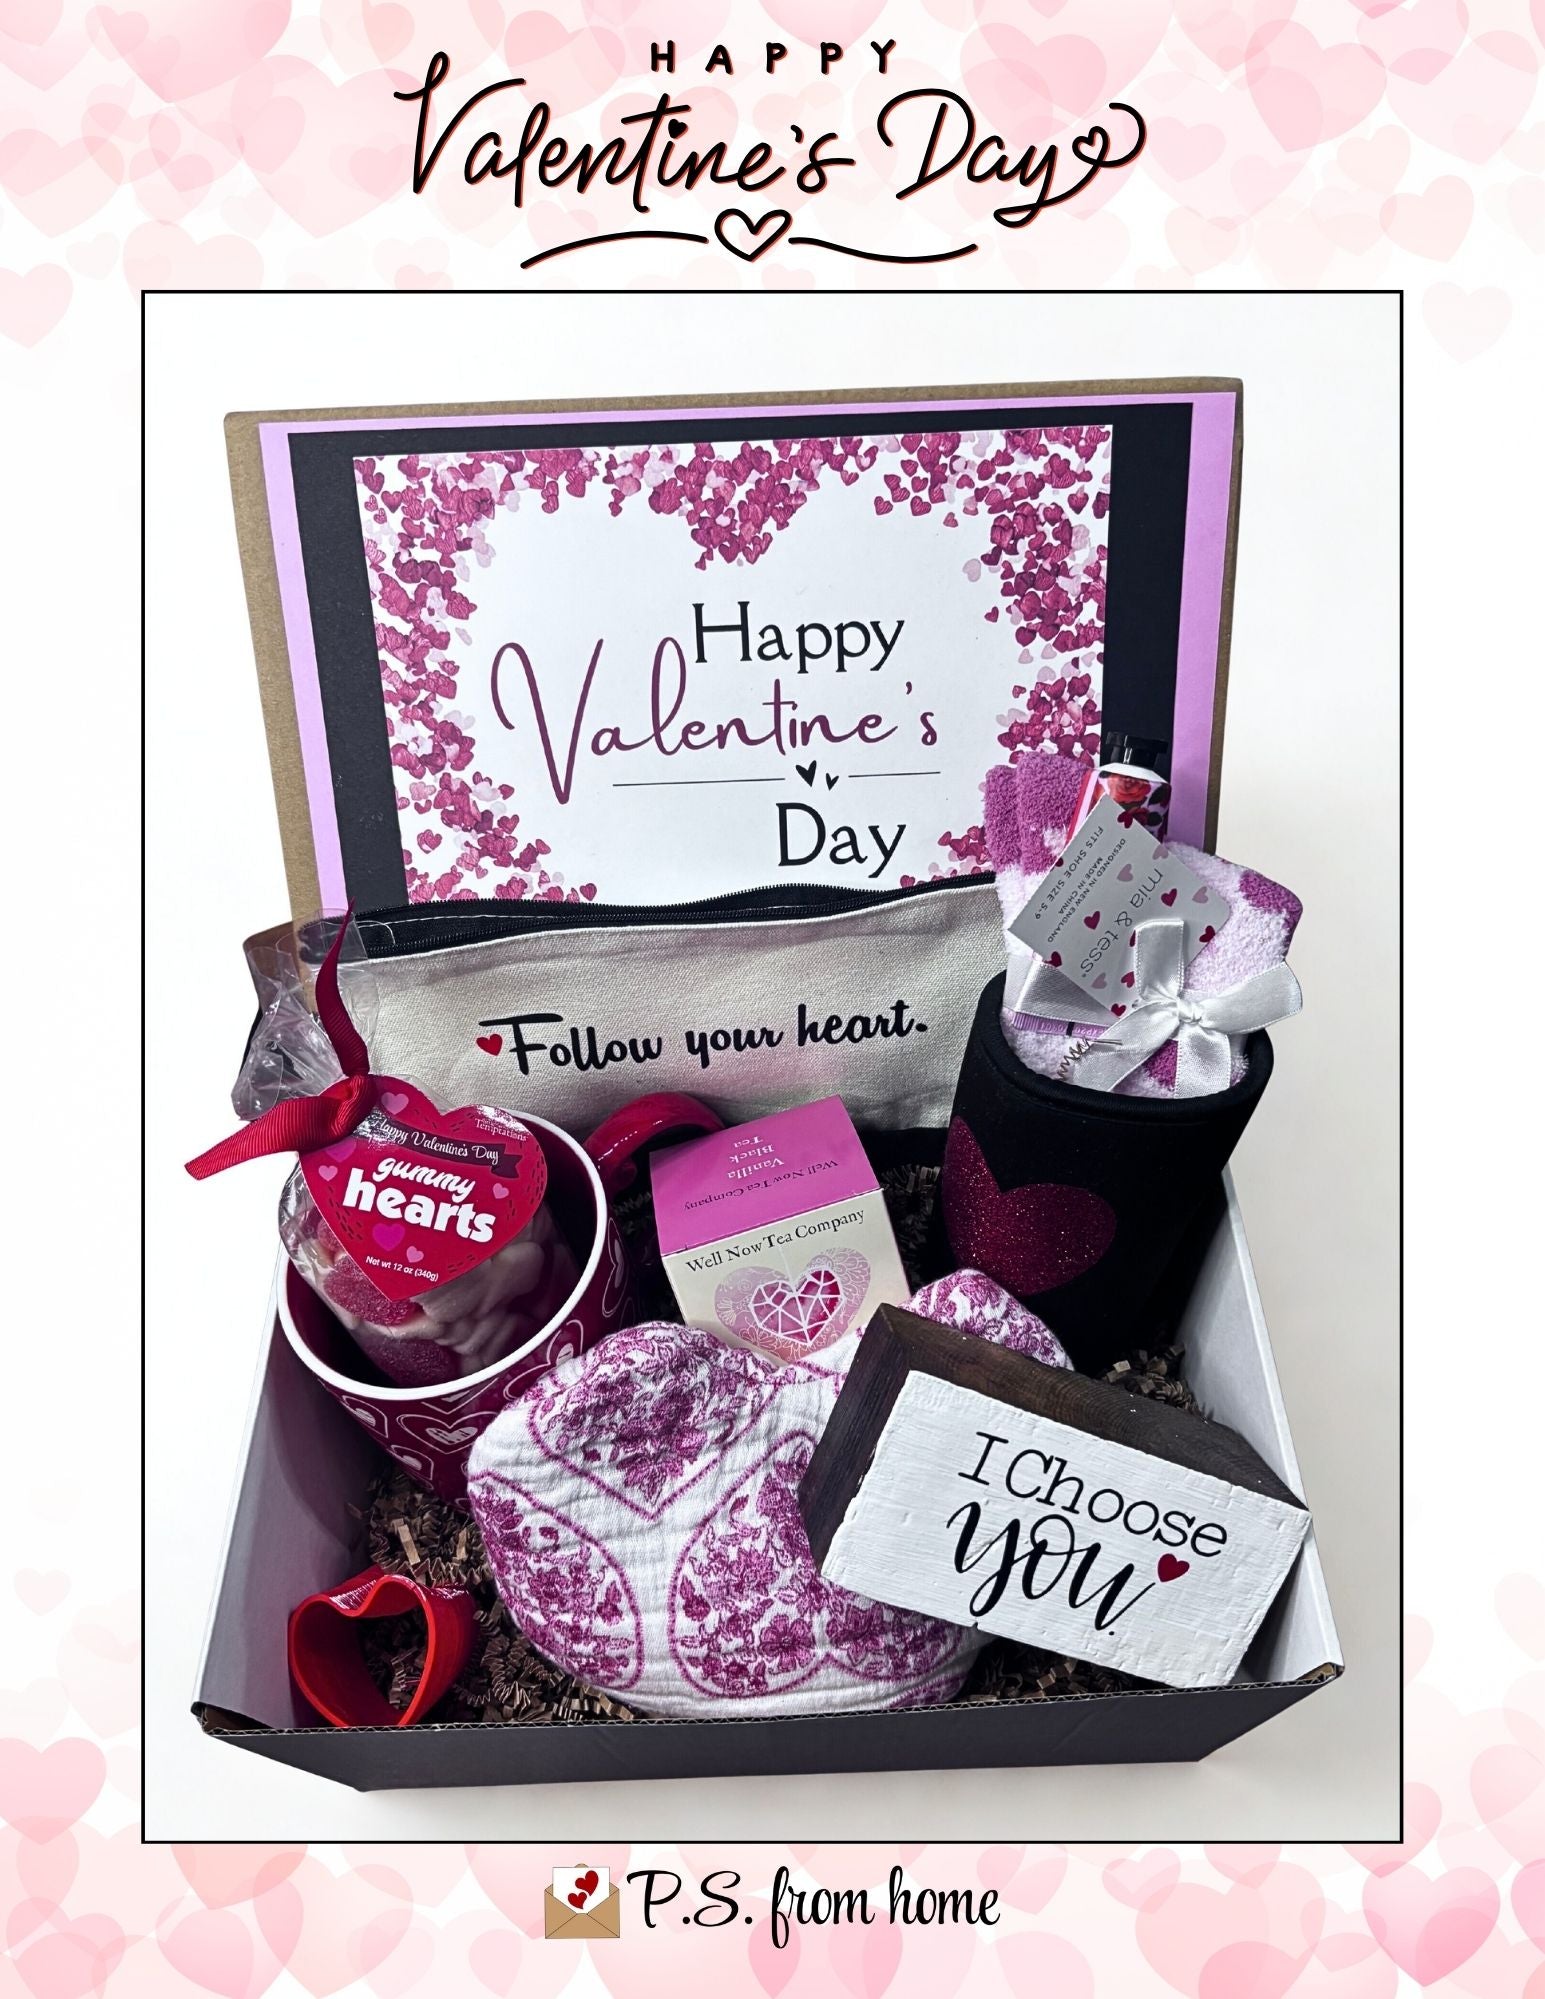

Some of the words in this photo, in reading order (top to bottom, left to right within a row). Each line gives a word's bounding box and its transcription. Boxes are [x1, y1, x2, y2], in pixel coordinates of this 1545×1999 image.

[692, 601, 906, 675] Happy
[490, 636, 939, 805] Valentine's
[775, 801, 908, 879] Day
[1085, 826, 1104, 849] FITS
[1063, 849, 1088, 879] SHOE
[1084, 857, 1104, 880] MADE
[1096, 838, 1126, 877] DESIGNED
[1046, 879, 1066, 903] SIZE
[1077, 880, 1086, 890] IN
[1088, 877, 1098, 888] IN
[1129, 867, 1164, 909] mia
[1057, 890, 1079, 915] CHINA
[1074, 888, 1091, 907] NEW
[1034, 902, 1049, 920] 5-9
[1113, 910, 1133, 928] &
[1046, 906, 1077, 943] ENGLAND
[478, 1013, 664, 1076] Follow
[684, 1029, 785, 1069] your
[797, 999, 929, 1047] heart.
[371, 1116, 408, 1145] Happy
[411, 1130, 469, 1158] Valentine's
[471, 1145, 500, 1166] Day
[474, 1117, 529, 1142] Temptations
[733, 1135, 764, 1149] Tea
[729, 1143, 776, 1164] Black
[372, 1157, 476, 1203] gummy
[727, 1157, 785, 1180] Vanilla
[773, 1169, 805, 1184] Now
[806, 1159, 839, 1176] Well
[746, 1178, 773, 1191] Tea
[342, 1167, 497, 1244] hearts
[684, 1188, 745, 1211] Company
[685, 1249, 724, 1273] Well
[726, 1240, 763, 1263] Now
[762, 1231, 794, 1251] Tea
[794, 1208, 866, 1240] Company
[365, 1255, 380, 1266] Net
[381, 1261, 392, 1269] wt
[393, 1262, 403, 1272] 12
[403, 1266, 414, 1274] oz
[414, 1268, 439, 1282] (340g)
[957, 1430, 1009, 1486] I
[1004, 1448, 1229, 1558] Choose
